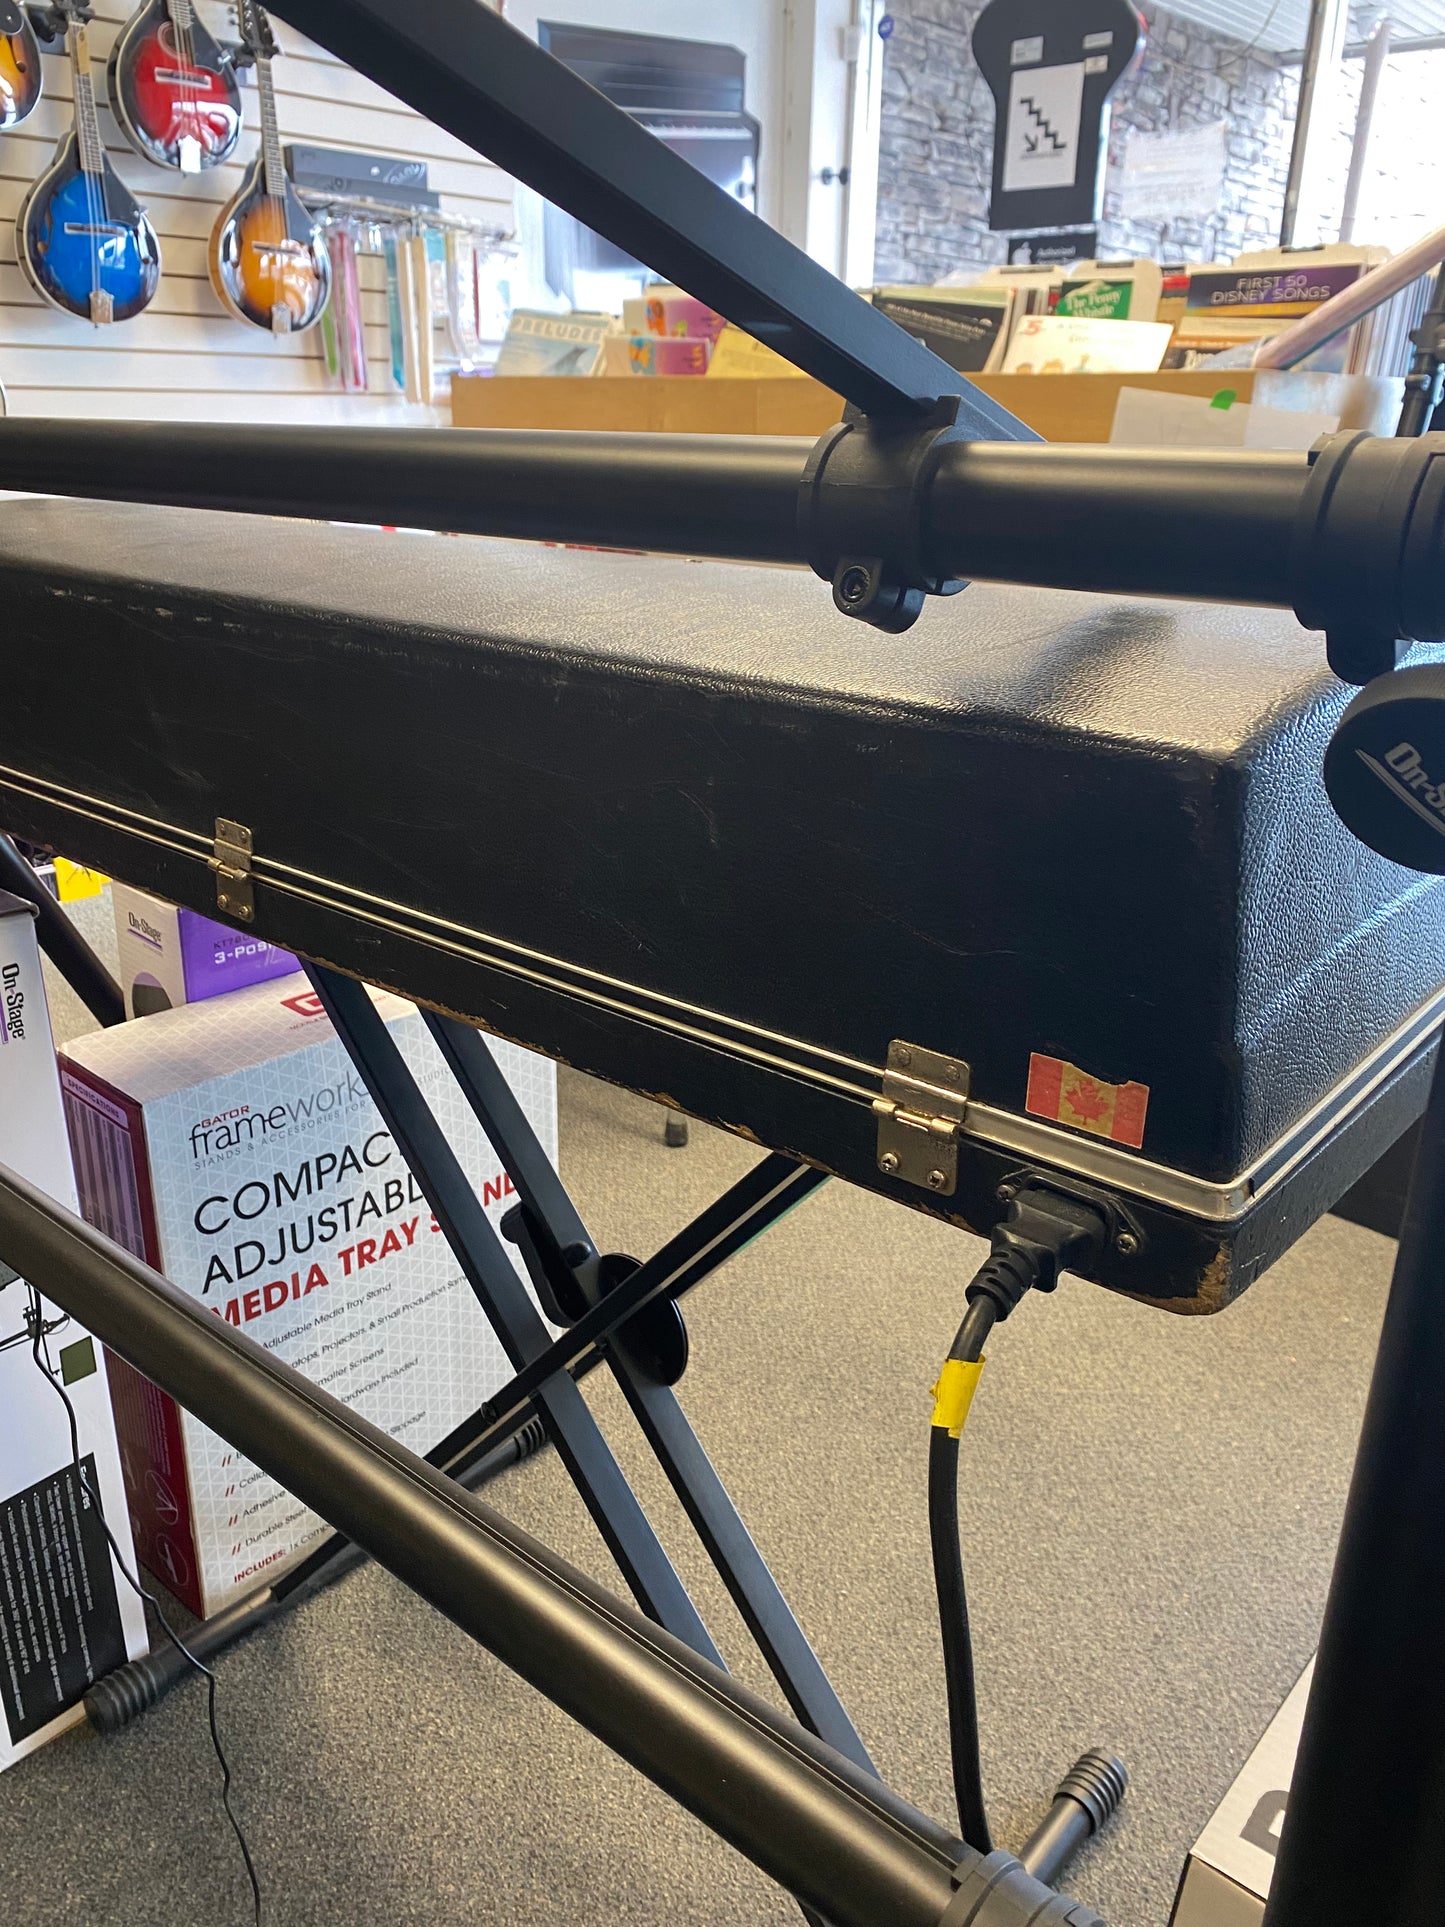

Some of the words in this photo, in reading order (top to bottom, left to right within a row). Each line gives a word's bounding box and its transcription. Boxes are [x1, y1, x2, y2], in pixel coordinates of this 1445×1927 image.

[1211, 287, 1271, 305] DISNEY
[1273, 285, 1331, 301] SONGS
[1236, 275, 1281, 290] FIRST
[1284, 275, 1307, 288] 50
[128, 911, 163, 942] On-Stage
[2, 963, 25, 1040] On-Stage
[67, 1079, 120, 1118] SPECIFICATIONS
[189, 1071, 370, 1159] framework
[200, 1105, 250, 1129] GATOR
[194, 1146, 242, 1171] STANDS
[247, 1141, 255, 1152] &
[261, 1112, 340, 1146] ACCESSORIES
[345, 1100, 366, 1115] FOR
[194, 1131, 392, 1235] COMPAC
[202, 1172, 423, 1295] ADJUSTABL
[211, 1262, 328, 1327] MEDIA
[337, 1215, 419, 1277] TRAY
[262, 1323, 313, 1349] Adjustable
[314, 1307, 345, 1326] Media
[346, 1296, 364, 1311] Tray
[366, 1282, 392, 1301] Stand
[377, 1309, 401, 1326] Small
[402, 1286, 446, 1313] Production
[349, 1348, 385, 1371] Screens
[243, 1490, 287, 1519] Adhesive
[246, 1522, 284, 1547] Durable
[285, 1507, 307, 1525] Steel
[233, 1549, 287, 1584] INCLUDES:
